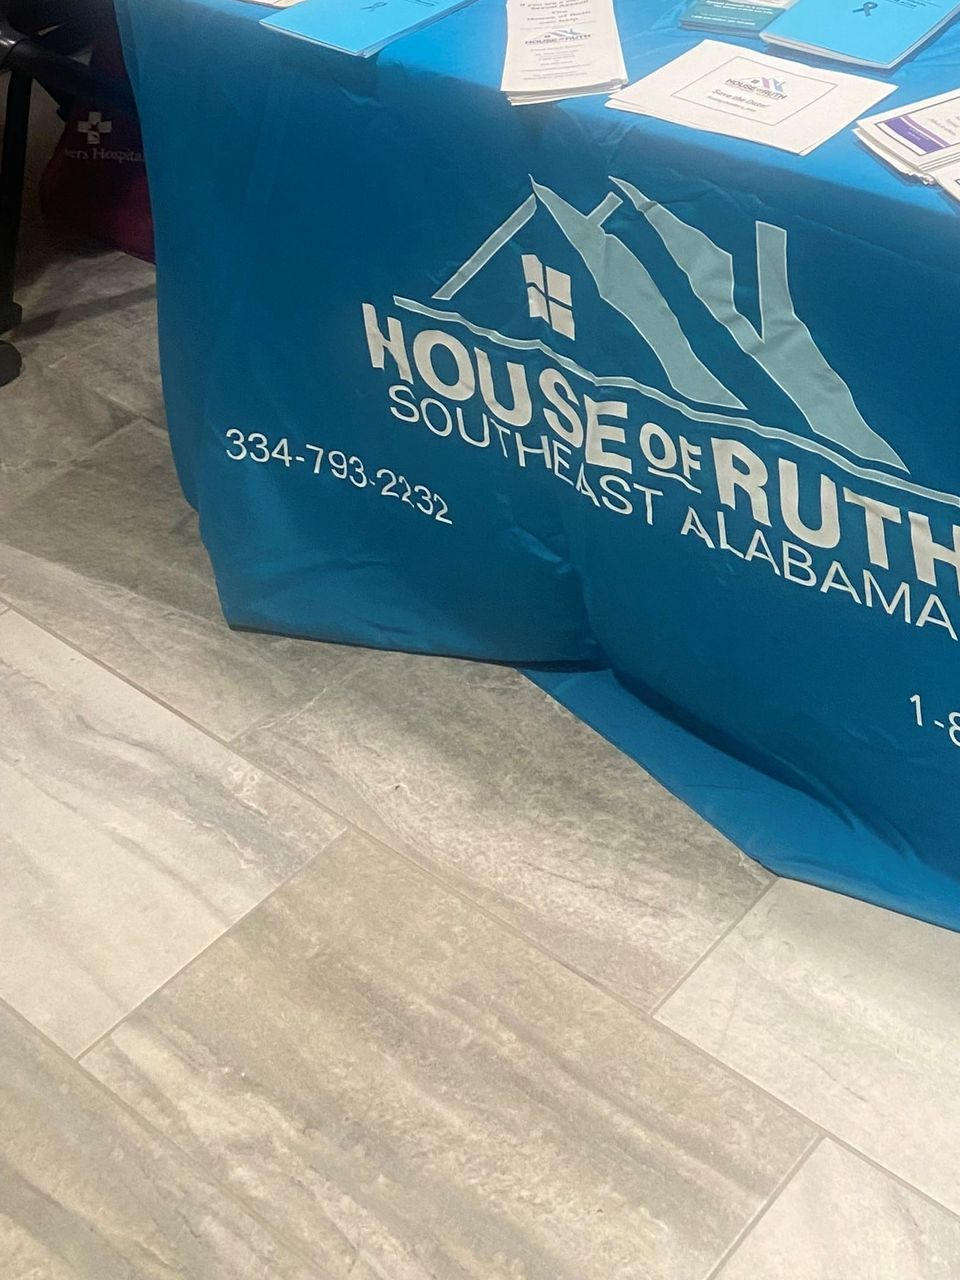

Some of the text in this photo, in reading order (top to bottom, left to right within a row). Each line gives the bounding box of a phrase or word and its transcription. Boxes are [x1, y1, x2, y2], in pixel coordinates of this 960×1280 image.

[725, 78, 757, 91] HOUSE
[763, 89, 788, 100] RUTH
[92, 147, 145, 163] Hospita
[361, 302, 633, 475] HOUSE
[639, 422, 702, 480] OF
[225, 428, 453, 525] 334-793-2232
[388, 384, 959, 642] SOUTHEAST ALABAMA
